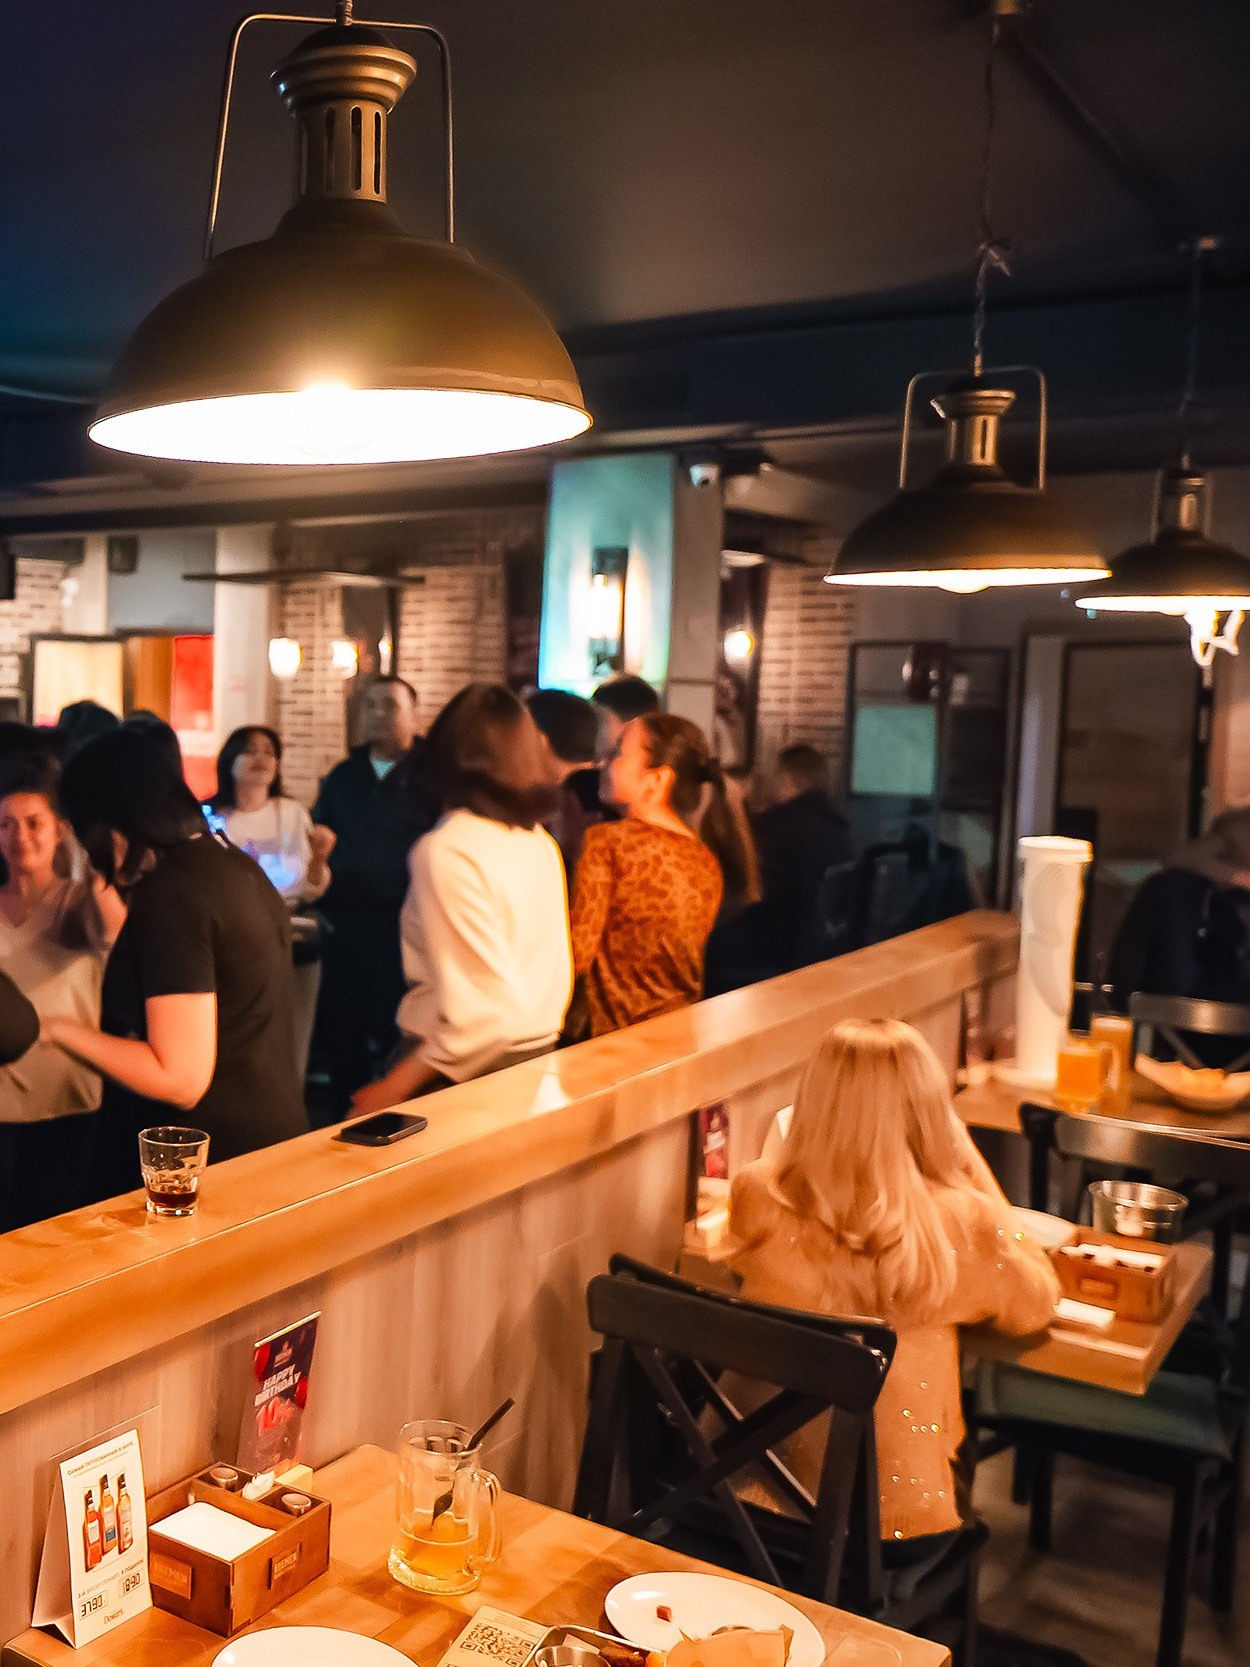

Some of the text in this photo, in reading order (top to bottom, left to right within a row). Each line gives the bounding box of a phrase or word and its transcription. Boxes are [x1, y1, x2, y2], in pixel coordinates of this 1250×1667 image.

[254, 1371, 302, 1407] BIRTHDAY
[262, 1364, 295, 1390] HAPPY
[80, 1595, 103, 1617] 3790
